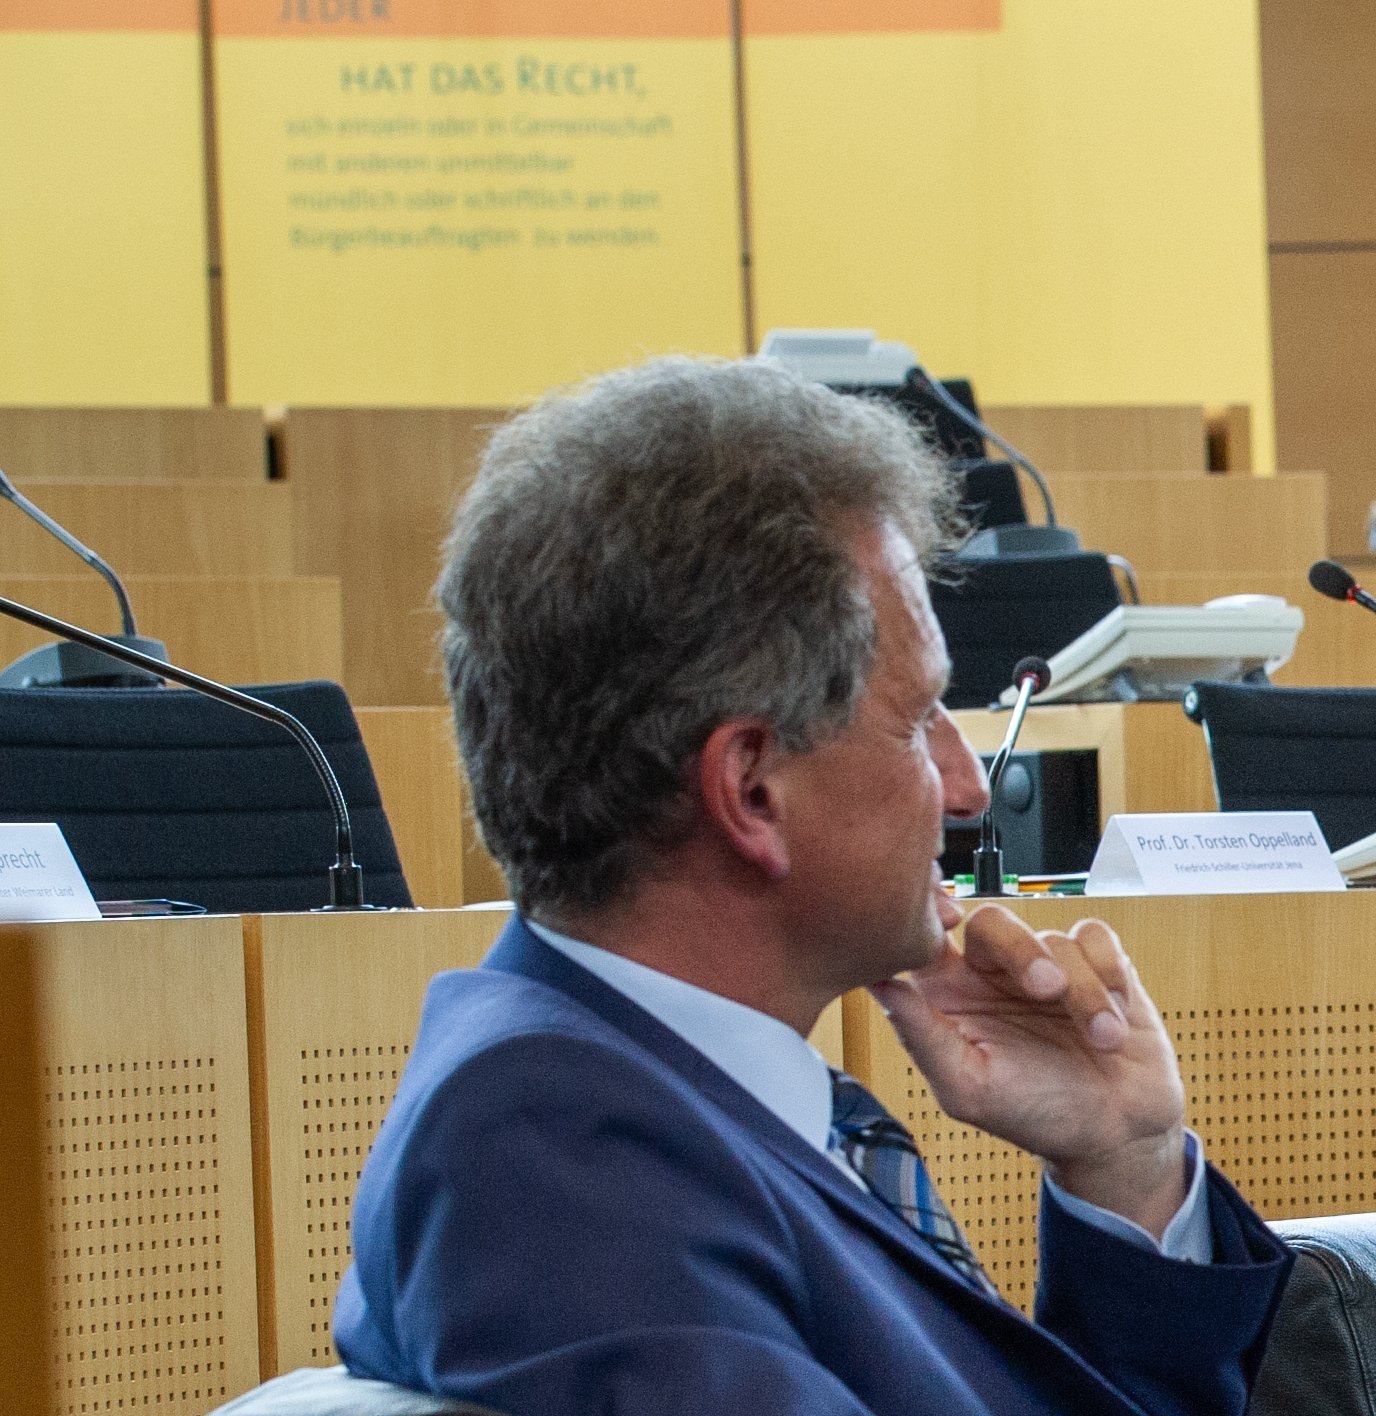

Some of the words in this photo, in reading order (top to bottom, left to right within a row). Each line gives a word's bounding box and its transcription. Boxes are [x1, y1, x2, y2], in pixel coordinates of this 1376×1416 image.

[339, 62, 416, 95] HAT
[428, 62, 506, 96] DAS
[1137, 835, 1172, 850] Prof.
[1172, 835, 1195, 850] Dr.
[1195, 834, 1249, 849] Torsten
[1249, 832, 1317, 850] Oppelland
